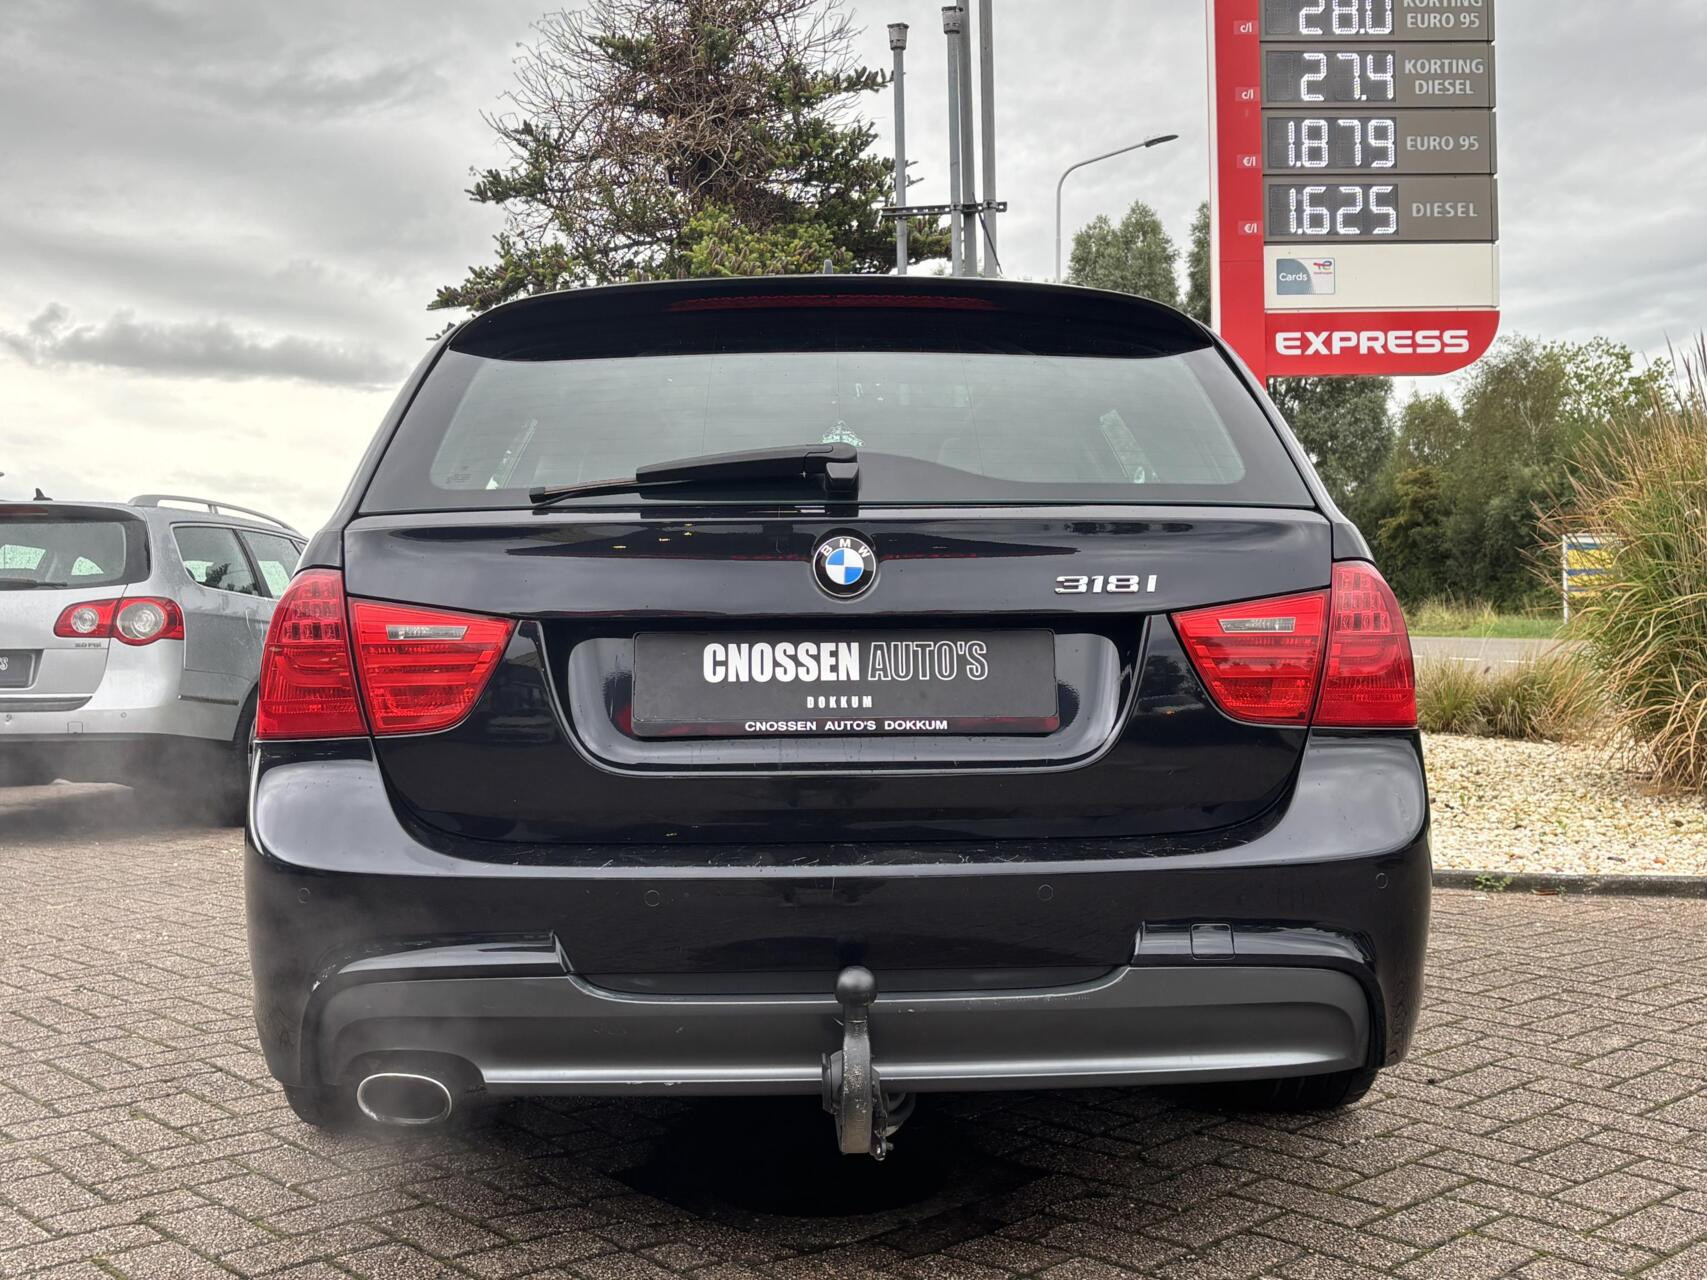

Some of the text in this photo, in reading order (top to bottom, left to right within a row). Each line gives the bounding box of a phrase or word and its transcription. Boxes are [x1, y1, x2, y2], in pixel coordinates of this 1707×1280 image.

[1407, 13, 1480, 28] EURO 95
[1404, 59, 1484, 75] KORTING
[1300, 53, 1394, 101] 27.4
[1415, 79, 1474, 95] DIESEL
[1288, 119, 1395, 168] 1.879
[1406, 136, 1480, 151] EURO 95
[1289, 186, 1397, 235] 1.625
[1411, 202, 1478, 218] DIESEL
[1279, 272, 1308, 281] Cards
[1275, 329, 1470, 356] EXPRESS
[821, 538, 871, 559] BMW
[703, 640, 989, 683] CNOSSEN AUTO'S
[807, 695, 873, 708] DOKKUM
[745, 719, 948, 732] CNOSSEN AUTO'S DOKKUM
